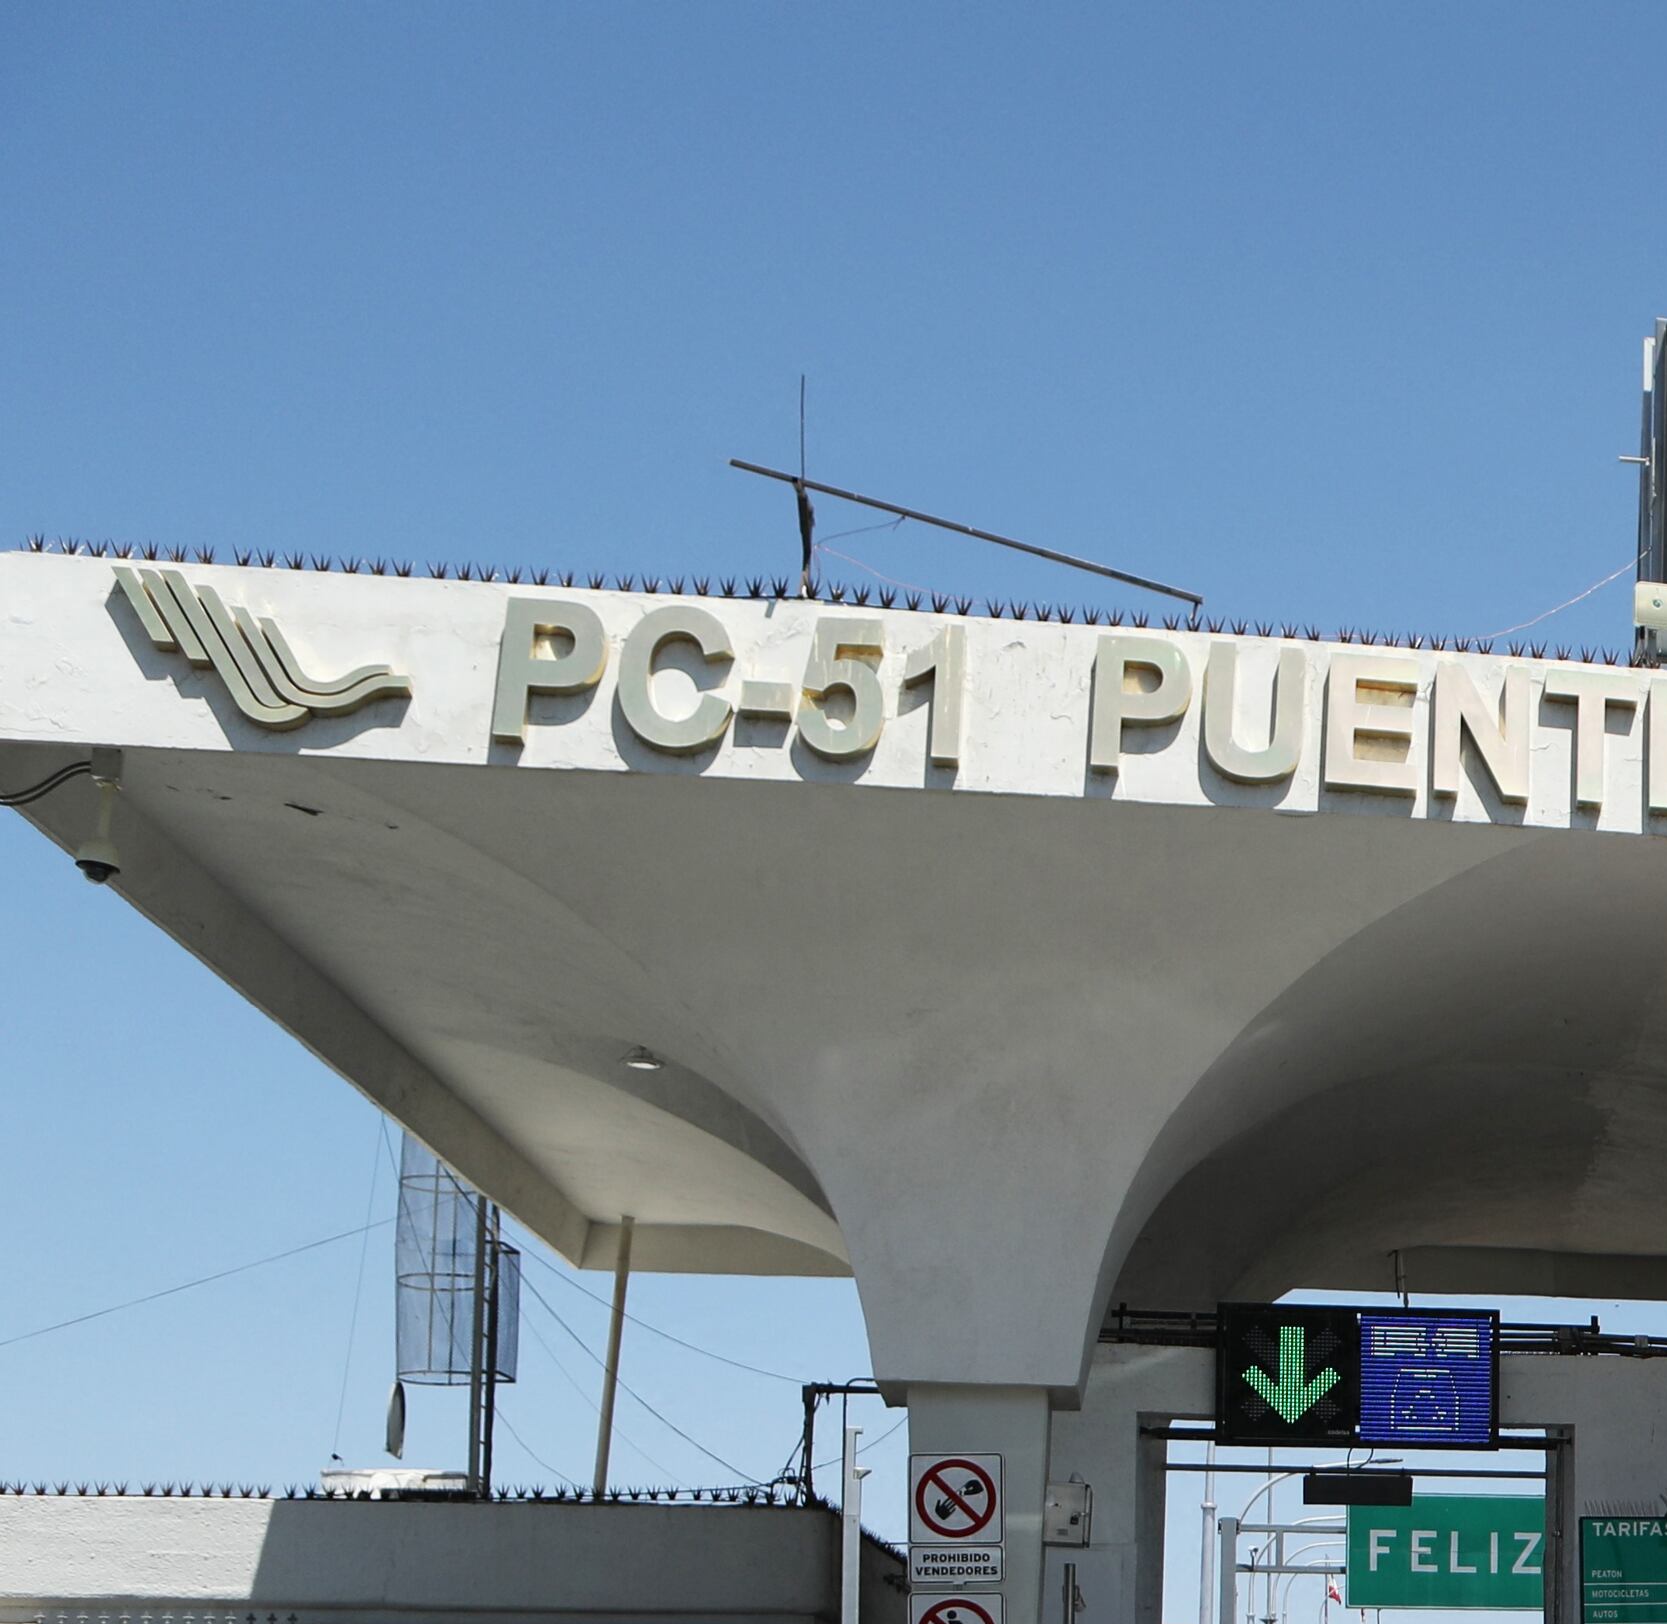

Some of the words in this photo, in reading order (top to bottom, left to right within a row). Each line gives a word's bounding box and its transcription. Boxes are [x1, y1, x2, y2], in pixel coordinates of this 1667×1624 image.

[493, 597, 966, 768] PC-51
[1369, 1529, 1542, 1574] FELIZ
[923, 1553, 990, 1563] PROHIBIDO
[915, 1566, 998, 1576] VENDEDORES
[1592, 1570, 1622, 1578] PEATON
[1592, 1589, 1649, 1598] MOTOCICLETAS
[1593, 1610, 1618, 1618] AUTOS
